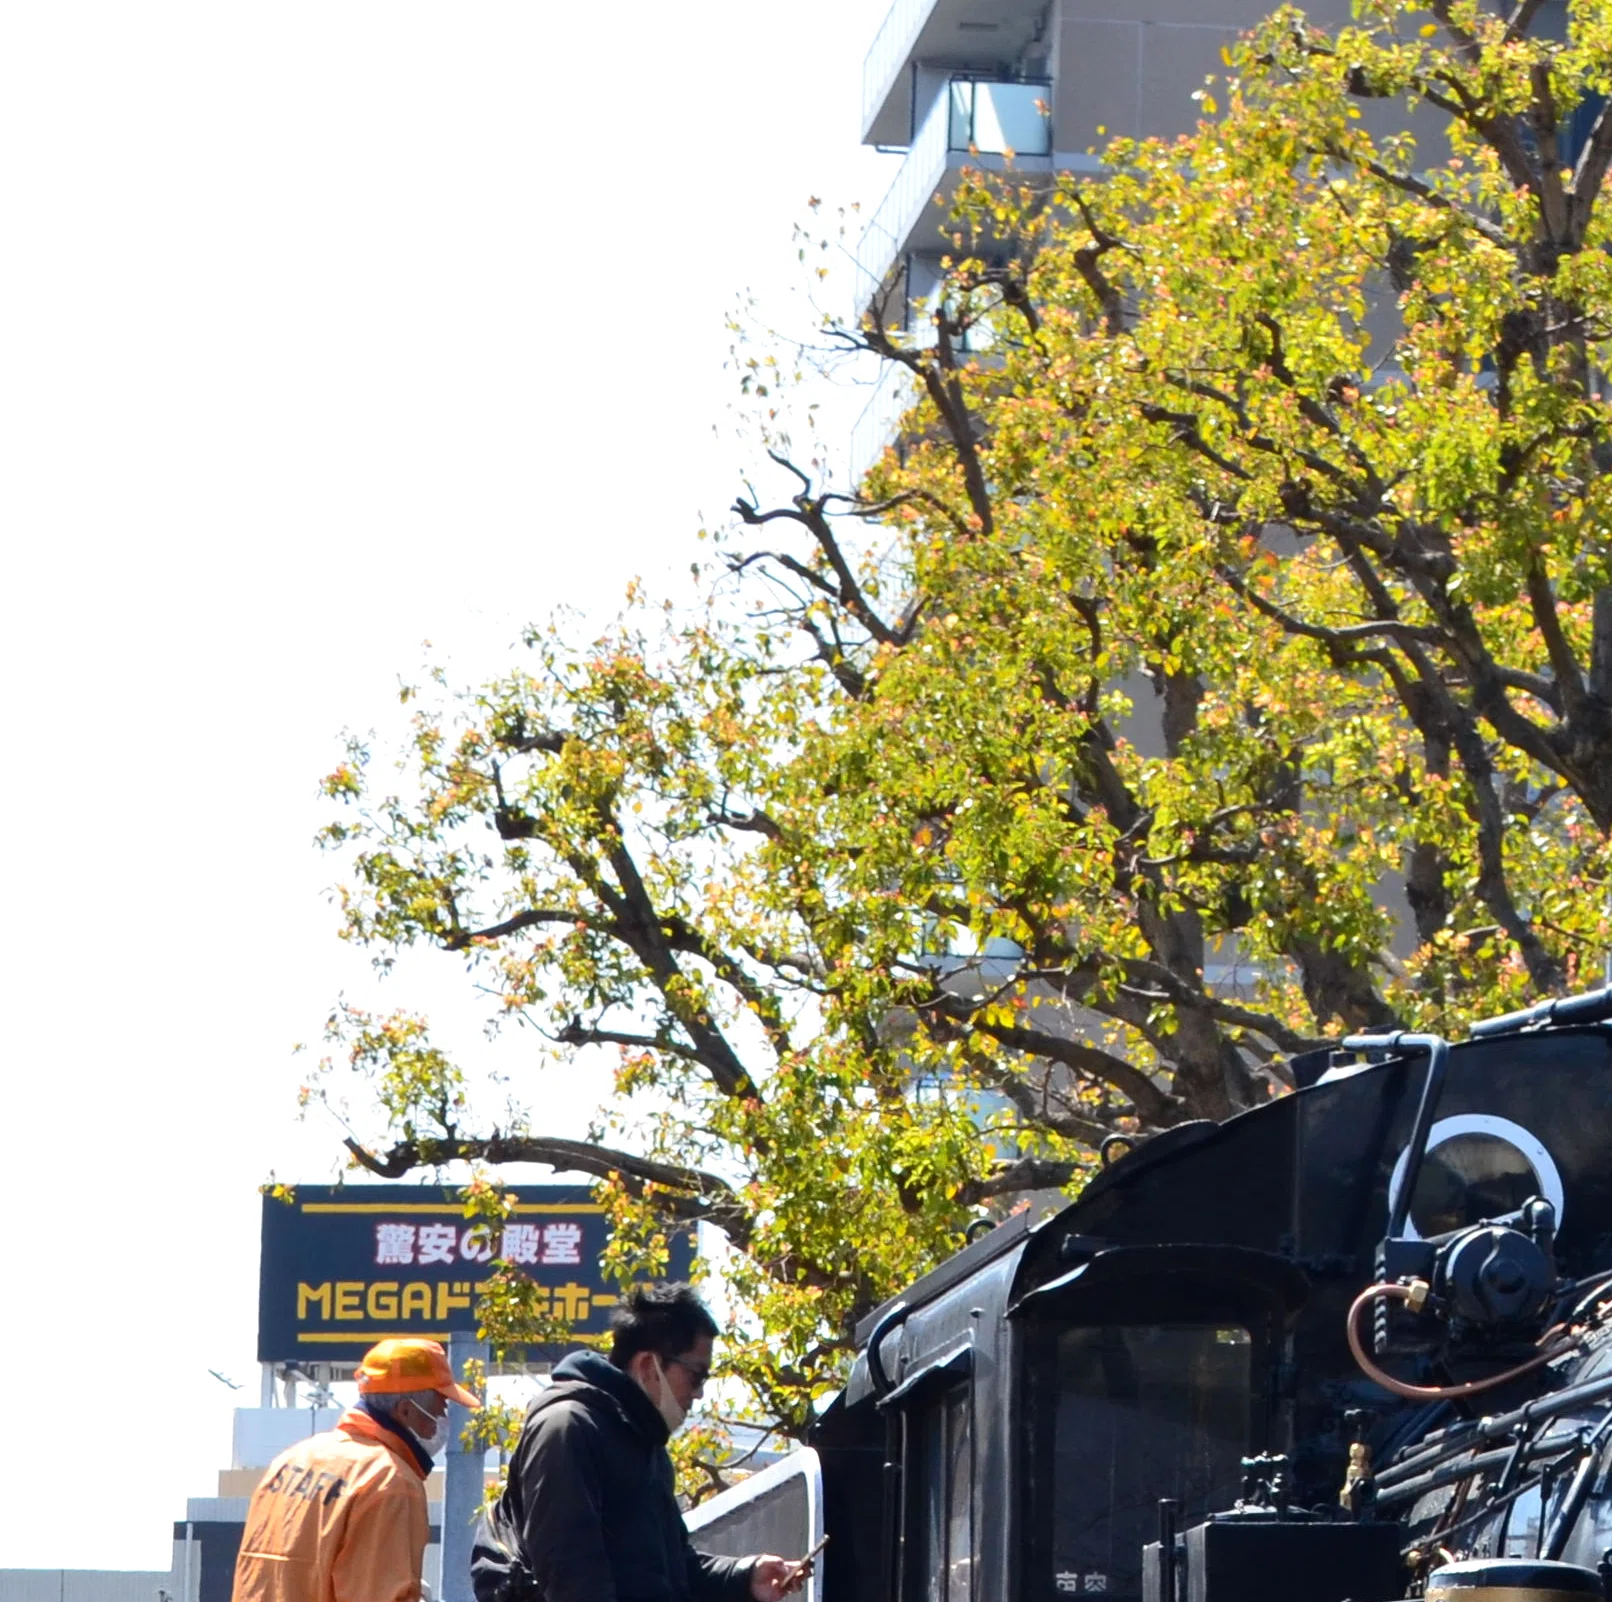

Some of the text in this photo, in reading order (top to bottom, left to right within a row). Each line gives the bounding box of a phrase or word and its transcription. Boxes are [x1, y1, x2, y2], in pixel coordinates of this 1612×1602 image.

[375, 1222, 581, 1265] 驚安の殿堂
[264, 1462, 347, 1506] STAFF
